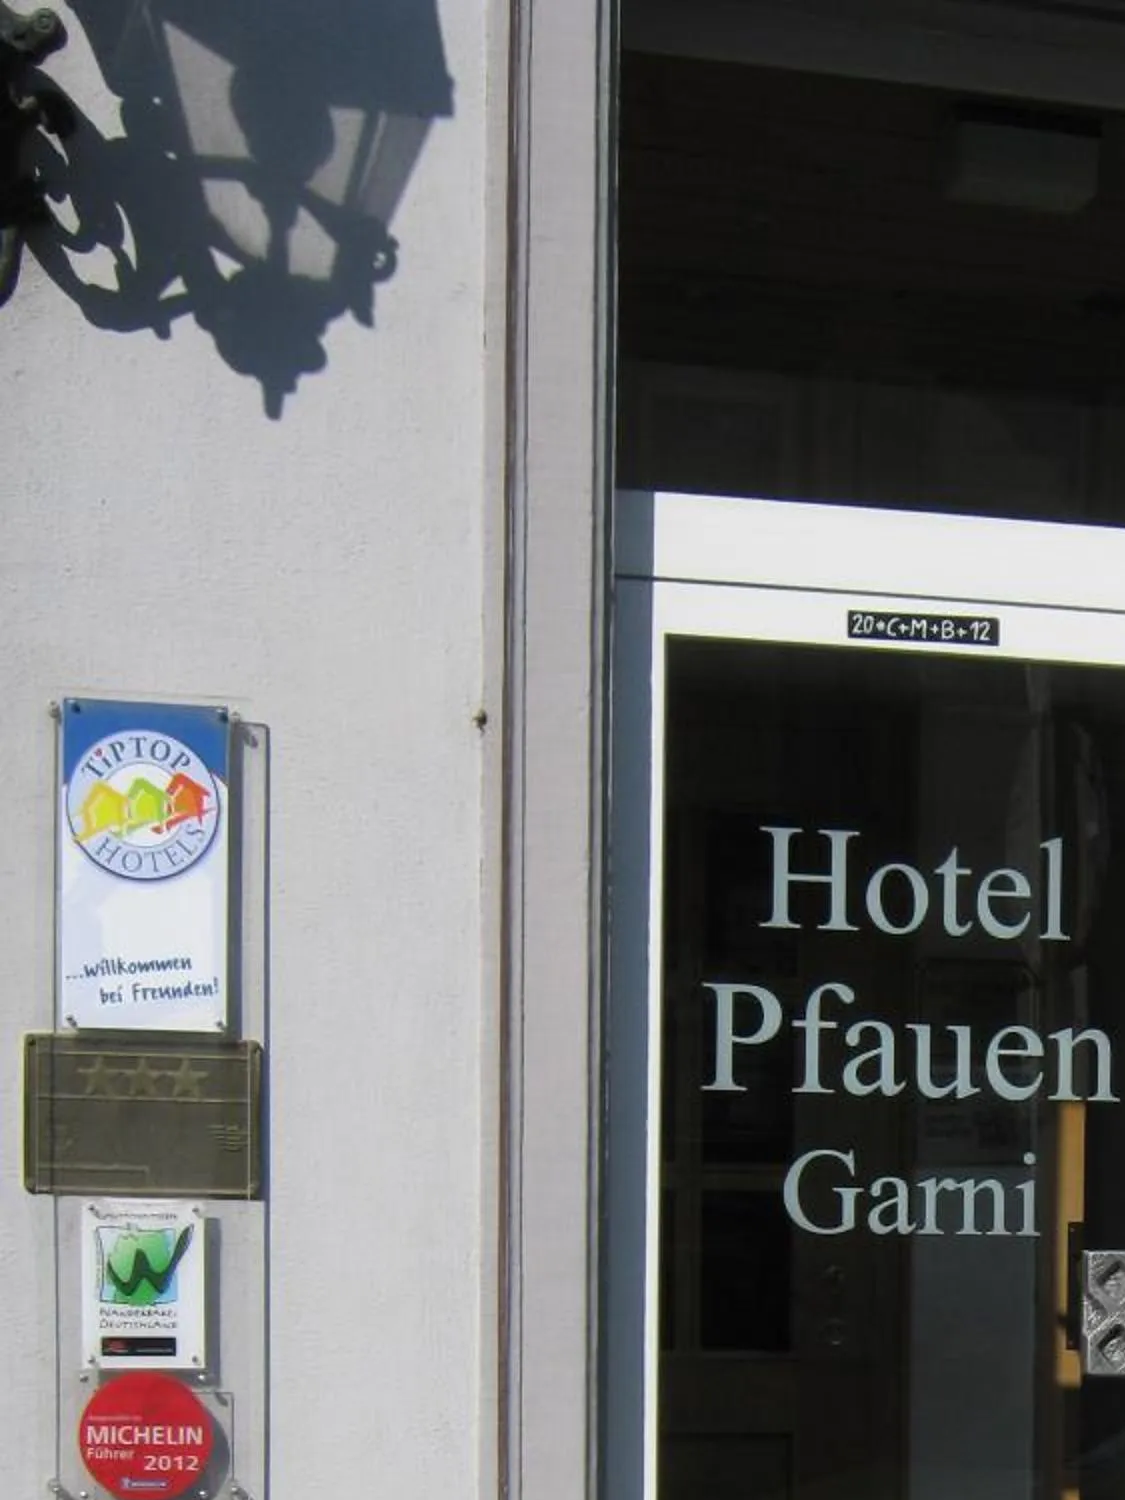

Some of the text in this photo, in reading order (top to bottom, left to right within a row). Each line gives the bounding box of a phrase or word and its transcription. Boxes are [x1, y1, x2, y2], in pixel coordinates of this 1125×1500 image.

[95, 824, 206, 874] HOTELS
[758, 826, 1071, 941] Hotel
[100, 985, 124, 1004] bei
[701, 982, 1121, 1102] Pfauen
[783, 1149, 1041, 1236] Garni
[86, 1425, 203, 1445] MICHELIN
[143, 1455, 200, 1471] 2012
